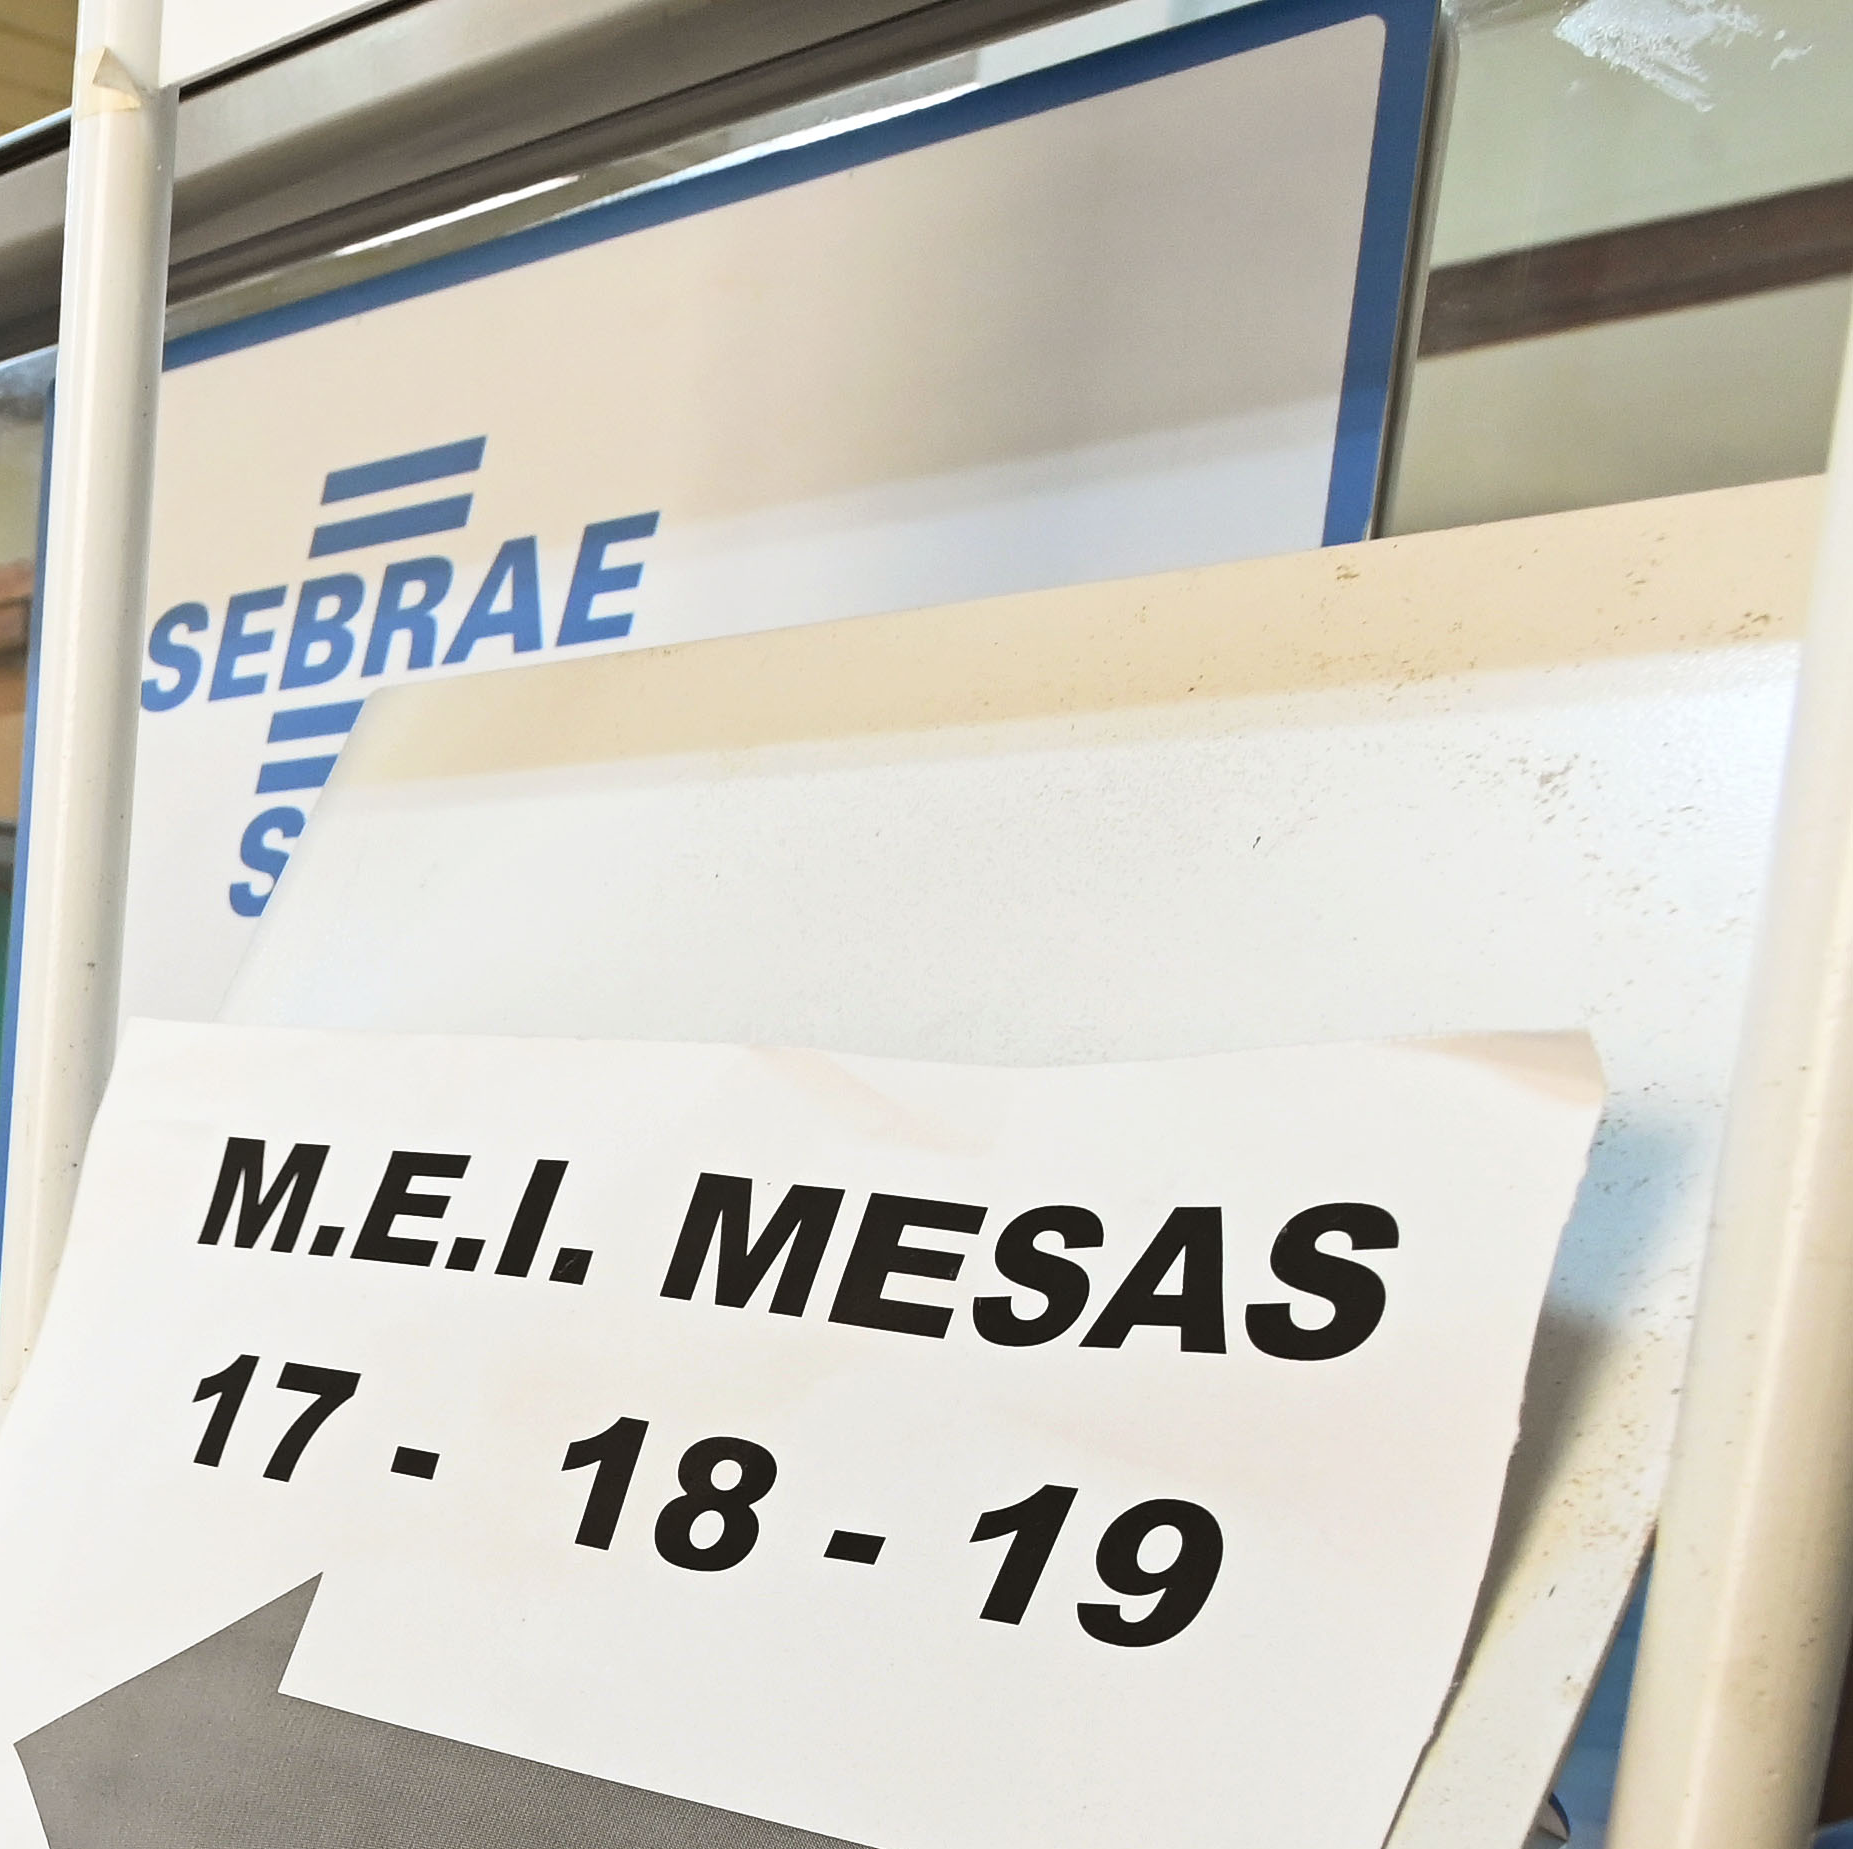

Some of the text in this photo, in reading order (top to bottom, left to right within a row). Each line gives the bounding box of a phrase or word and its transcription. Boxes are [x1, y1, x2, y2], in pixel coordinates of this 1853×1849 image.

[140, 510, 660, 713] SEBRAE
[197, 1137, 1400, 1361] M.E.I. MESAS
[192, 1354, 361, 1482] 17
[561, 1416, 777, 1572] 18
[968, 1484, 1224, 1648] 19
